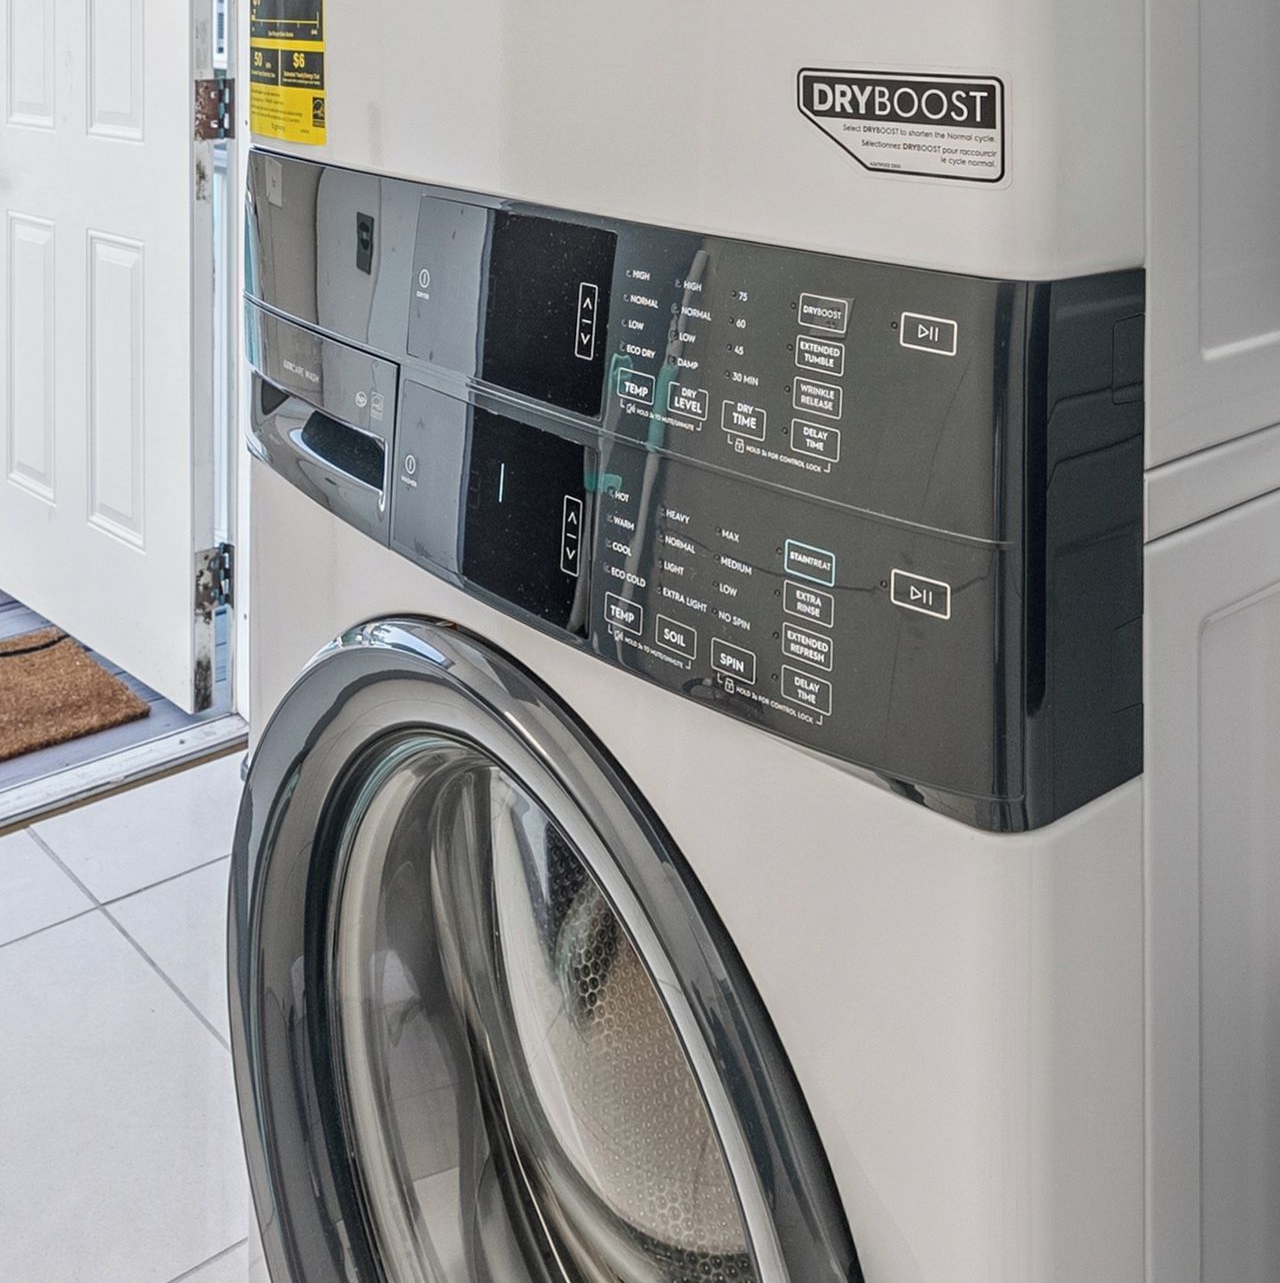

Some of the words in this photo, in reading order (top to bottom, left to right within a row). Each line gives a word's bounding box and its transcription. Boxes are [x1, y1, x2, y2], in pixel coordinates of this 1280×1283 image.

[812, 82, 988, 122] DRYBOOST
[842, 124, 861, 133] Select
[862, 125, 900, 136] DRYBOOST
[900, 128, 907, 136] to
[908, 128, 933, 138] shorten
[934, 130, 946, 139] the
[948, 131, 973, 141] Normal
[974, 134, 996, 144] cycle.
[902, 142, 941, 154] DRYBOOST
[942, 147, 958, 156] pour
[960, 148, 997, 158] raccourcir
[940, 156, 946, 164] le
[948, 157, 966, 167] cycle
[968, 158, 996, 168] normal.
[632, 270, 650, 281] HIGH
[683, 280, 702, 292] HIGH
[630, 294, 658, 309] NORMAL
[738, 292, 748, 302] 75
[680, 306, 712, 321] NORMAL
[802, 304, 842, 320] DRYBOOST
[628, 320, 644, 330] LOW
[736, 318, 746, 329] 60
[679, 332, 696, 343] LOW
[626, 344, 640, 355] ECO
[641, 348, 656, 359] DRY
[734, 344, 744, 356] 45
[800, 340, 840, 358] EXTENDED
[677, 358, 698, 370] DAMP
[804, 352, 834, 368] TUMBLE
[732, 372, 742, 382] 30
[744, 374, 759, 386] MIN
[624, 381, 649, 398] TEMP
[681, 386, 698, 399] DRY
[800, 383, 835, 400] WRINKLE
[674, 397, 702, 414] LEVEL
[737, 402, 754, 415] DRY
[800, 395, 834, 411] RELEASE
[732, 412, 757, 430] TIME
[803, 426, 828, 440] DELAY
[806, 438, 824, 452] TIME
[614, 492, 630, 503] HOT
[614, 516, 635, 531] WARM
[666, 508, 690, 524] HEAVY
[722, 529, 740, 543] MAX
[612, 541, 632, 556] COOL
[665, 536, 696, 554] NORMAL
[664, 561, 684, 576] LIGHT
[720, 556, 753, 575] MEDIUM
[790, 550, 832, 571] STAINTREAT
[610, 566, 626, 581] ECO
[626, 572, 646, 588] COLD
[720, 583, 738, 597] LOW
[796, 589, 822, 606] EXTRA
[662, 587, 686, 604] EXTRA
[686, 596, 708, 613] LIGHT
[610, 604, 635, 624] TEMP
[796, 602, 820, 618] RINSE
[718, 610, 730, 624] NO
[732, 614, 751, 630] SPIN
[663, 628, 686, 648] SOIL
[787, 630, 828, 652] EXTENDED
[790, 642, 825, 663] REFRESH
[720, 653, 744, 673] SPIN
[794, 676, 820, 693] DELAY
[797, 689, 816, 704] TIME
